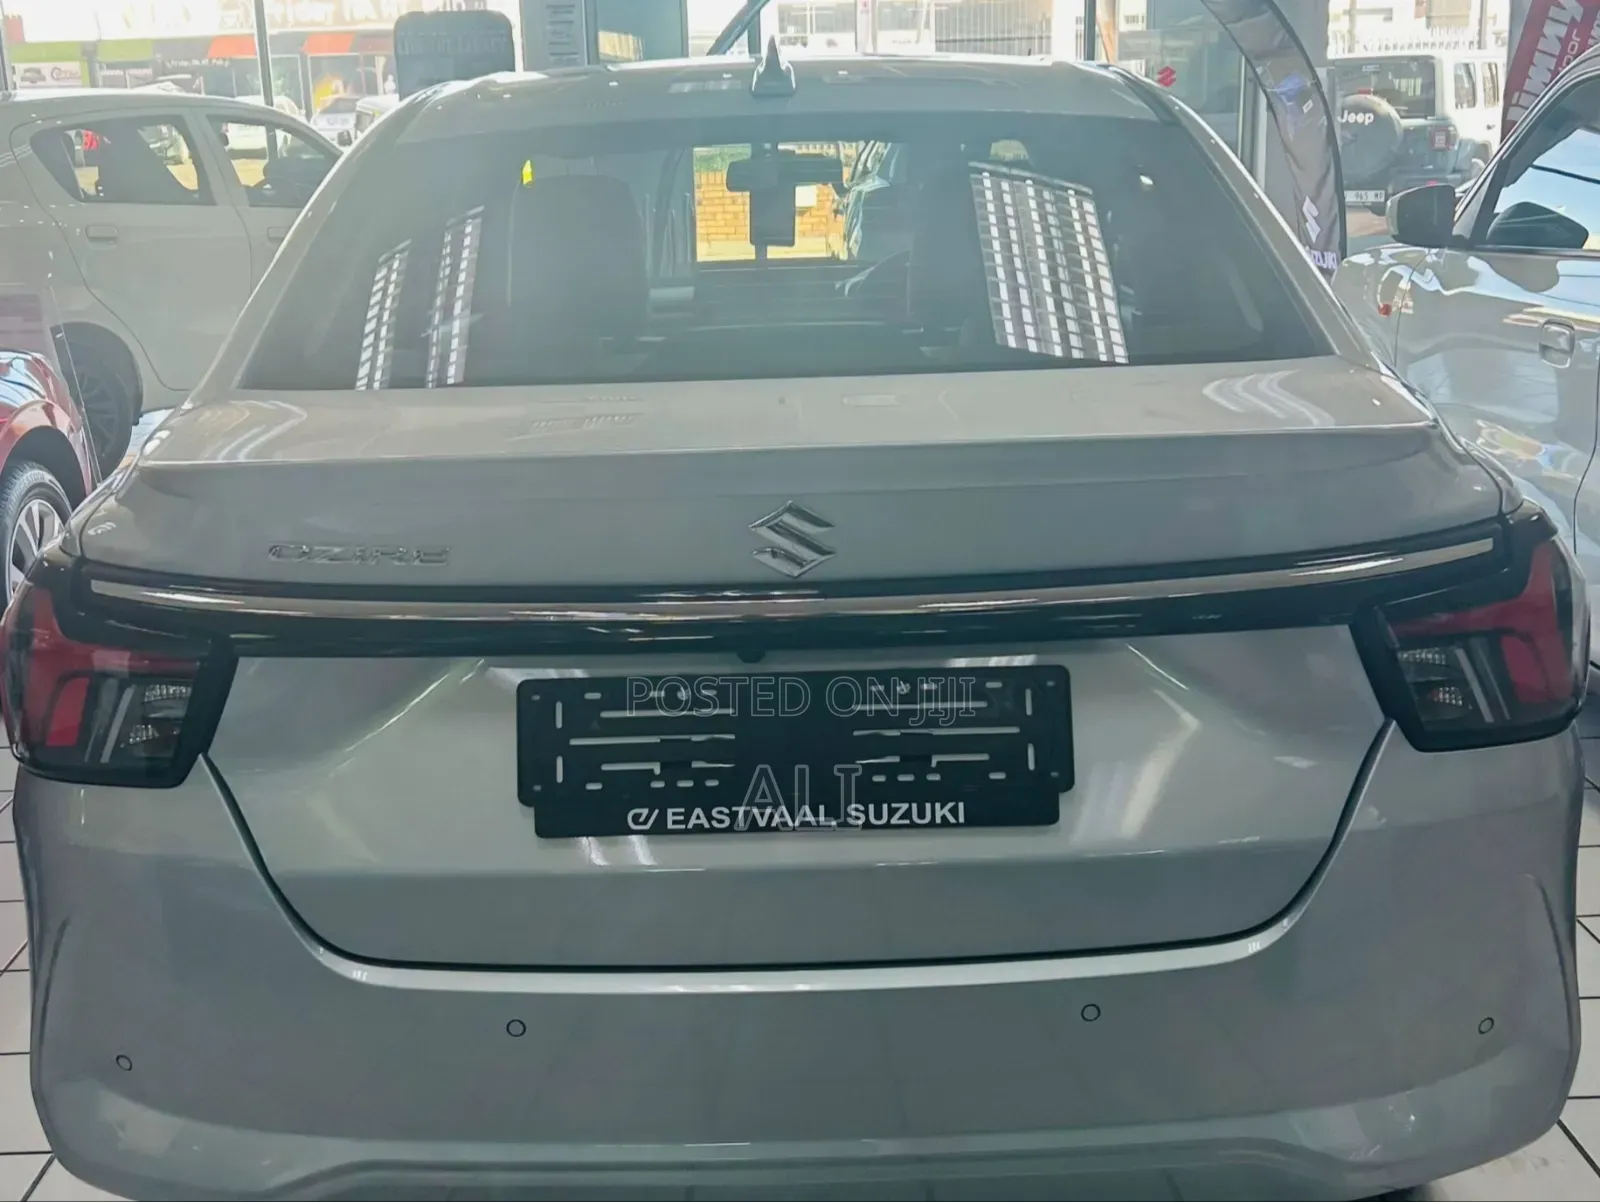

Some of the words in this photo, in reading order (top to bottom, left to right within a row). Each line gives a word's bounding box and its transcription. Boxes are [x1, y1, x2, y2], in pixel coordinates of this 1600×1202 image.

[1558, 28, 1581, 70] oor
[1336, 109, 1374, 126] Jeep
[666, 805, 836, 830] EASTVAAL
[846, 802, 966, 828] SUZUKI
